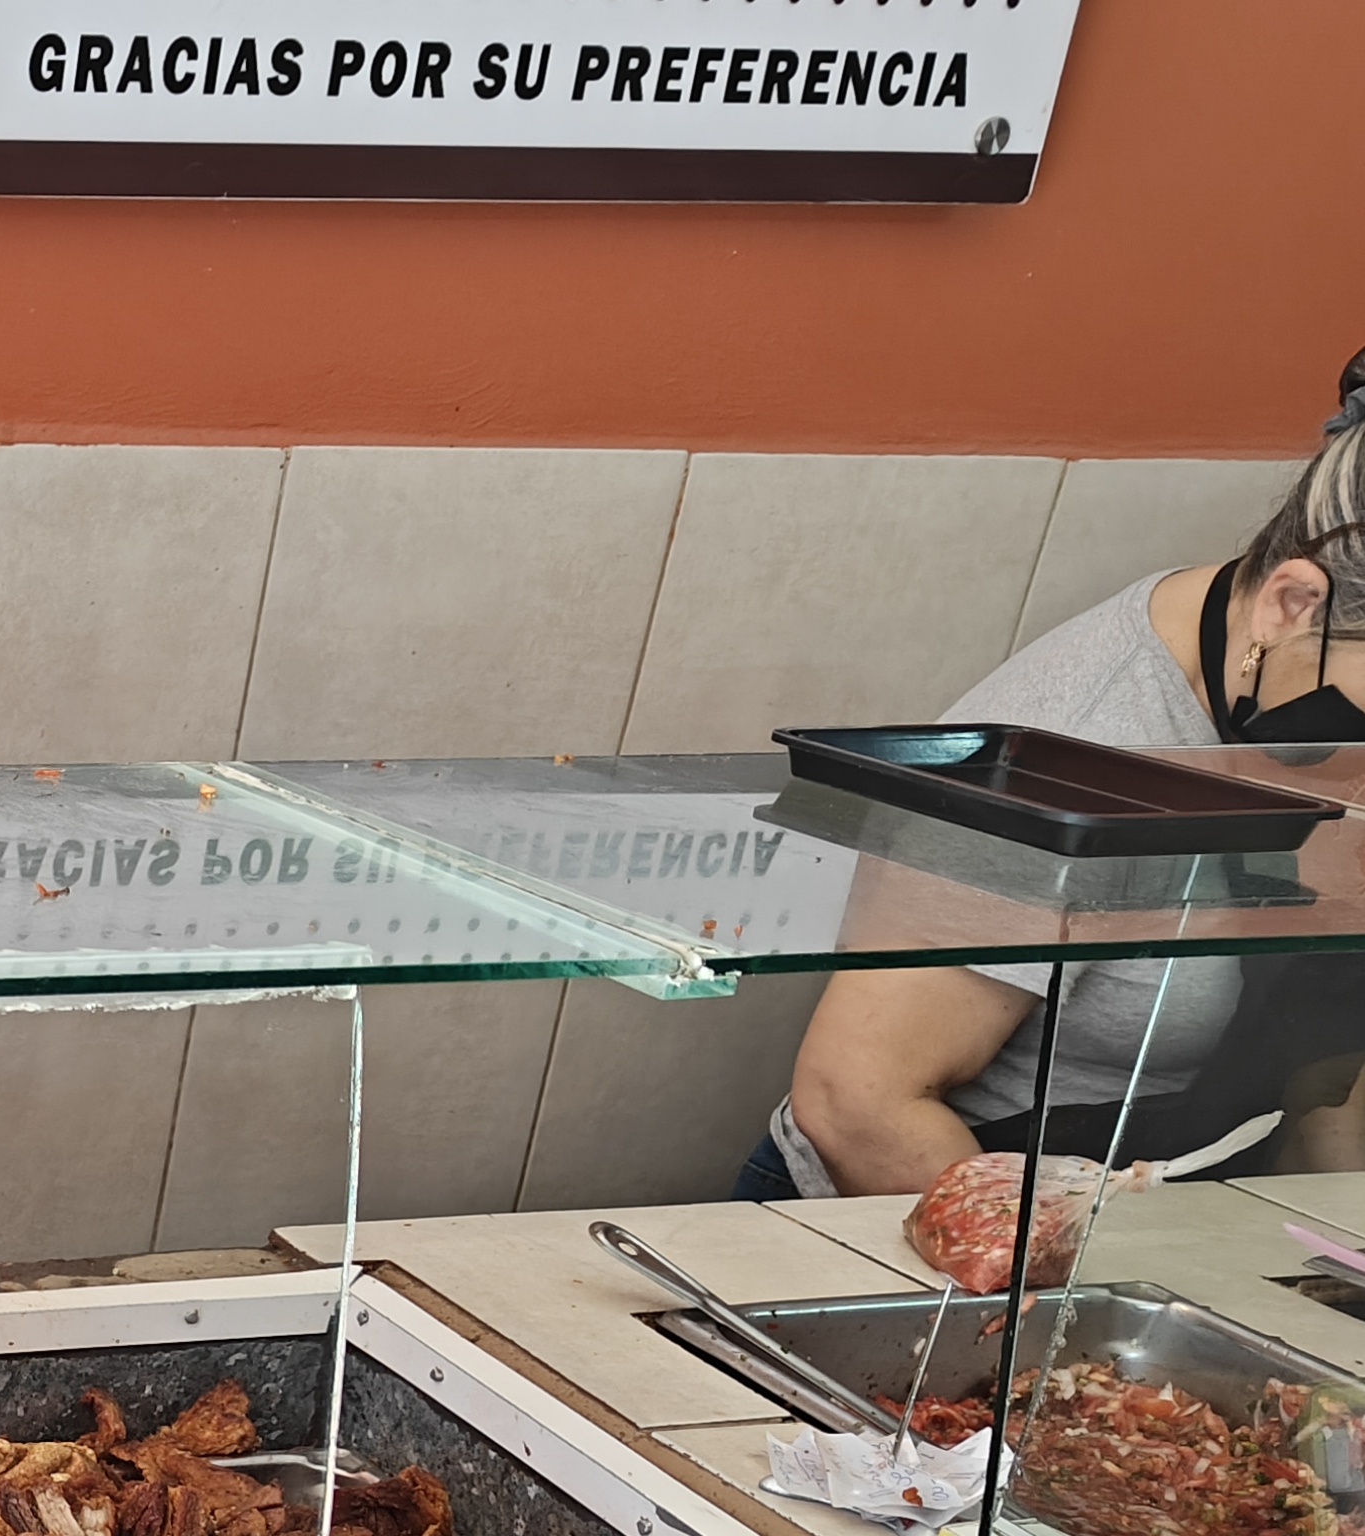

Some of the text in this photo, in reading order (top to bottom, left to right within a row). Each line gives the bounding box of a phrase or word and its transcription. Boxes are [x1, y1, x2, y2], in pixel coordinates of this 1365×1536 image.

[28, 33, 969, 108] GRACIAS POR SU PREFERENCIA
